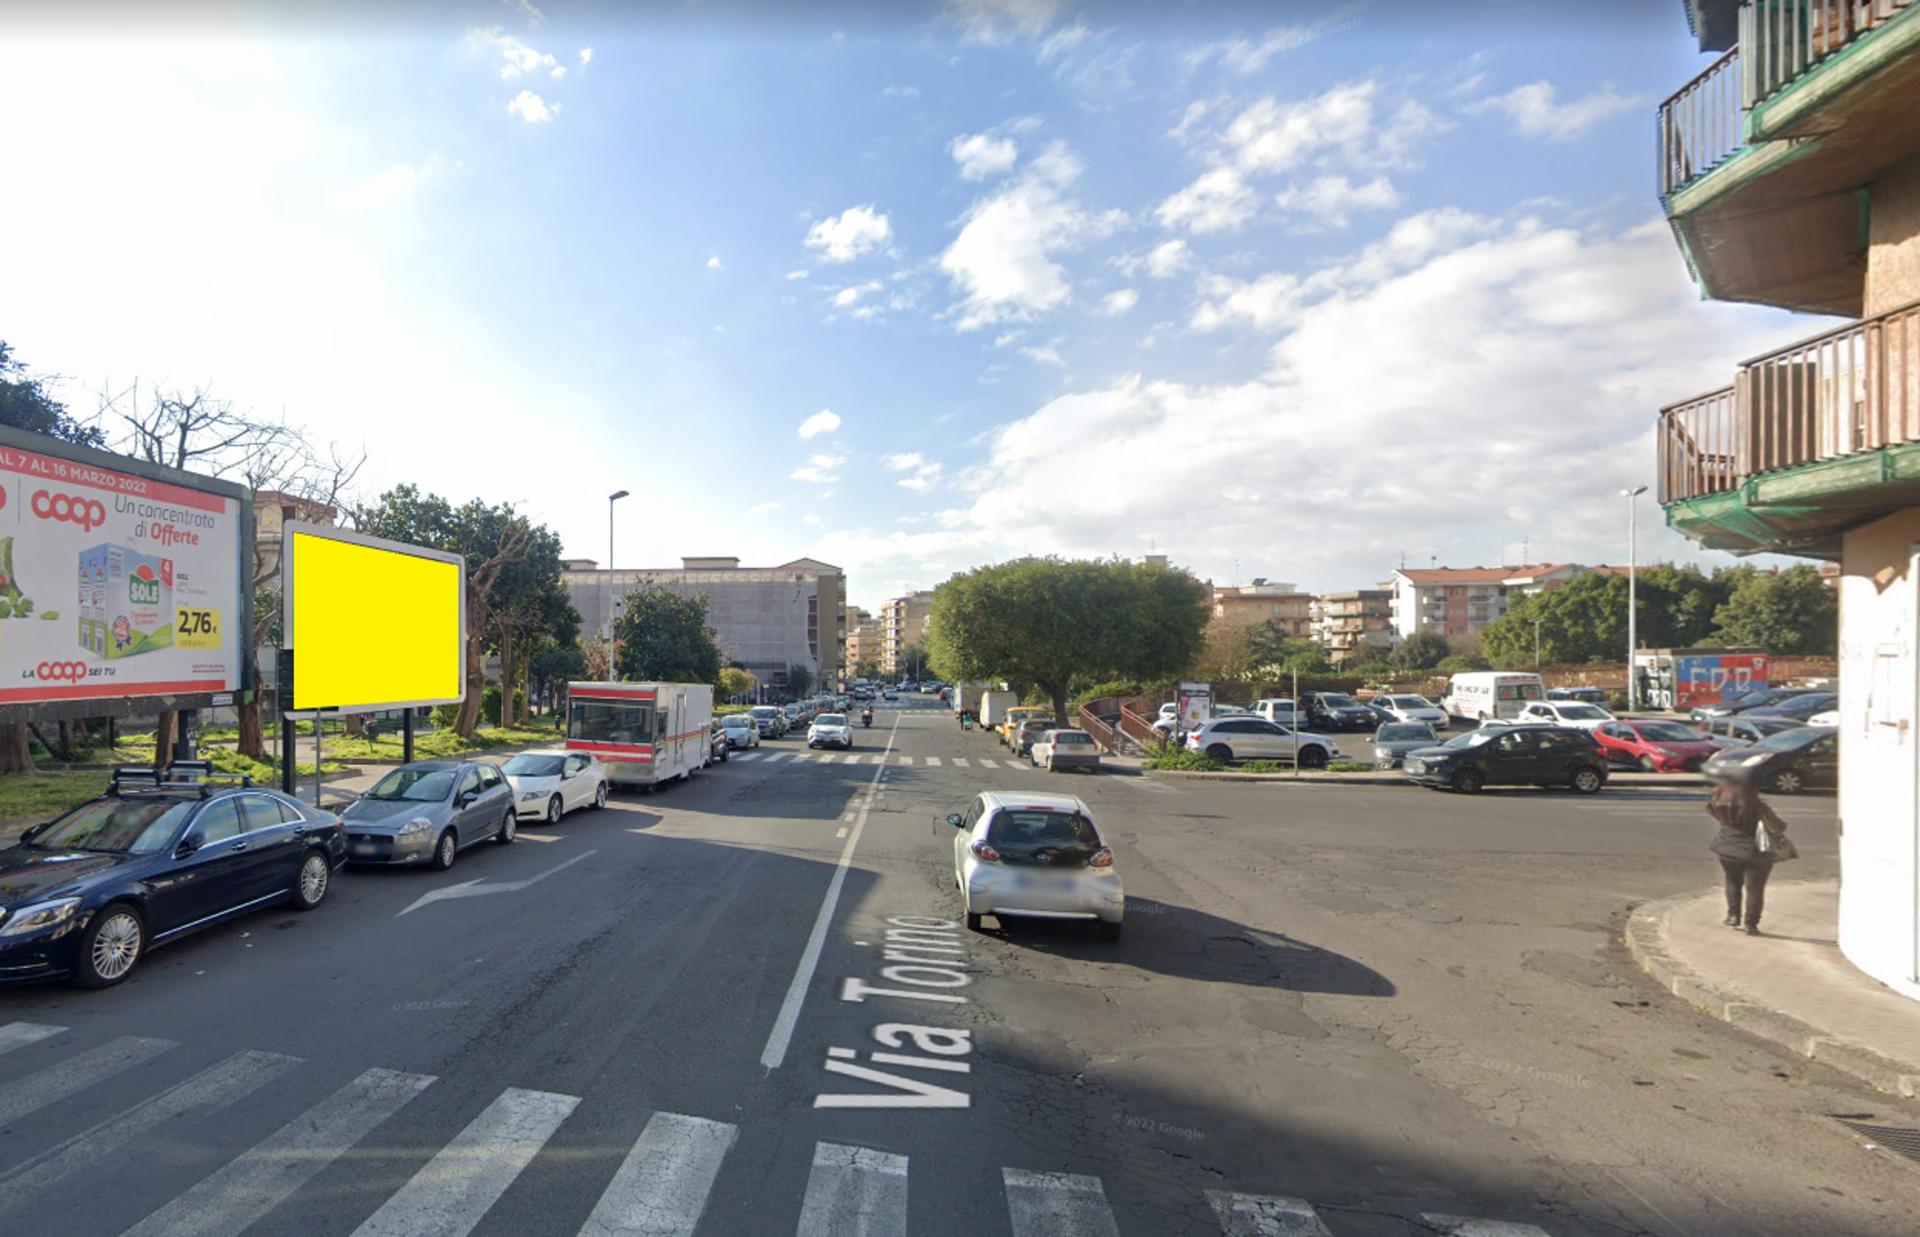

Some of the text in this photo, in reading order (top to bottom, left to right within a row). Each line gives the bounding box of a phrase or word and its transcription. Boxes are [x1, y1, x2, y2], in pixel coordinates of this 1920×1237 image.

[18, 455, 26, 467] 7
[31, 459, 49, 473] AL
[54, 463, 67, 477] 16
[70, 467, 116, 486] MARZO
[119, 477, 147, 493] 2022
[31, 489, 106, 533] coop
[115, 494, 215, 529] Un concentrato
[135, 520, 199, 547] di Offerte
[131, 582, 159, 603] SOLE
[178, 610, 212, 637] 2,76
[22, 660, 116, 684] LA coop SEI TU
